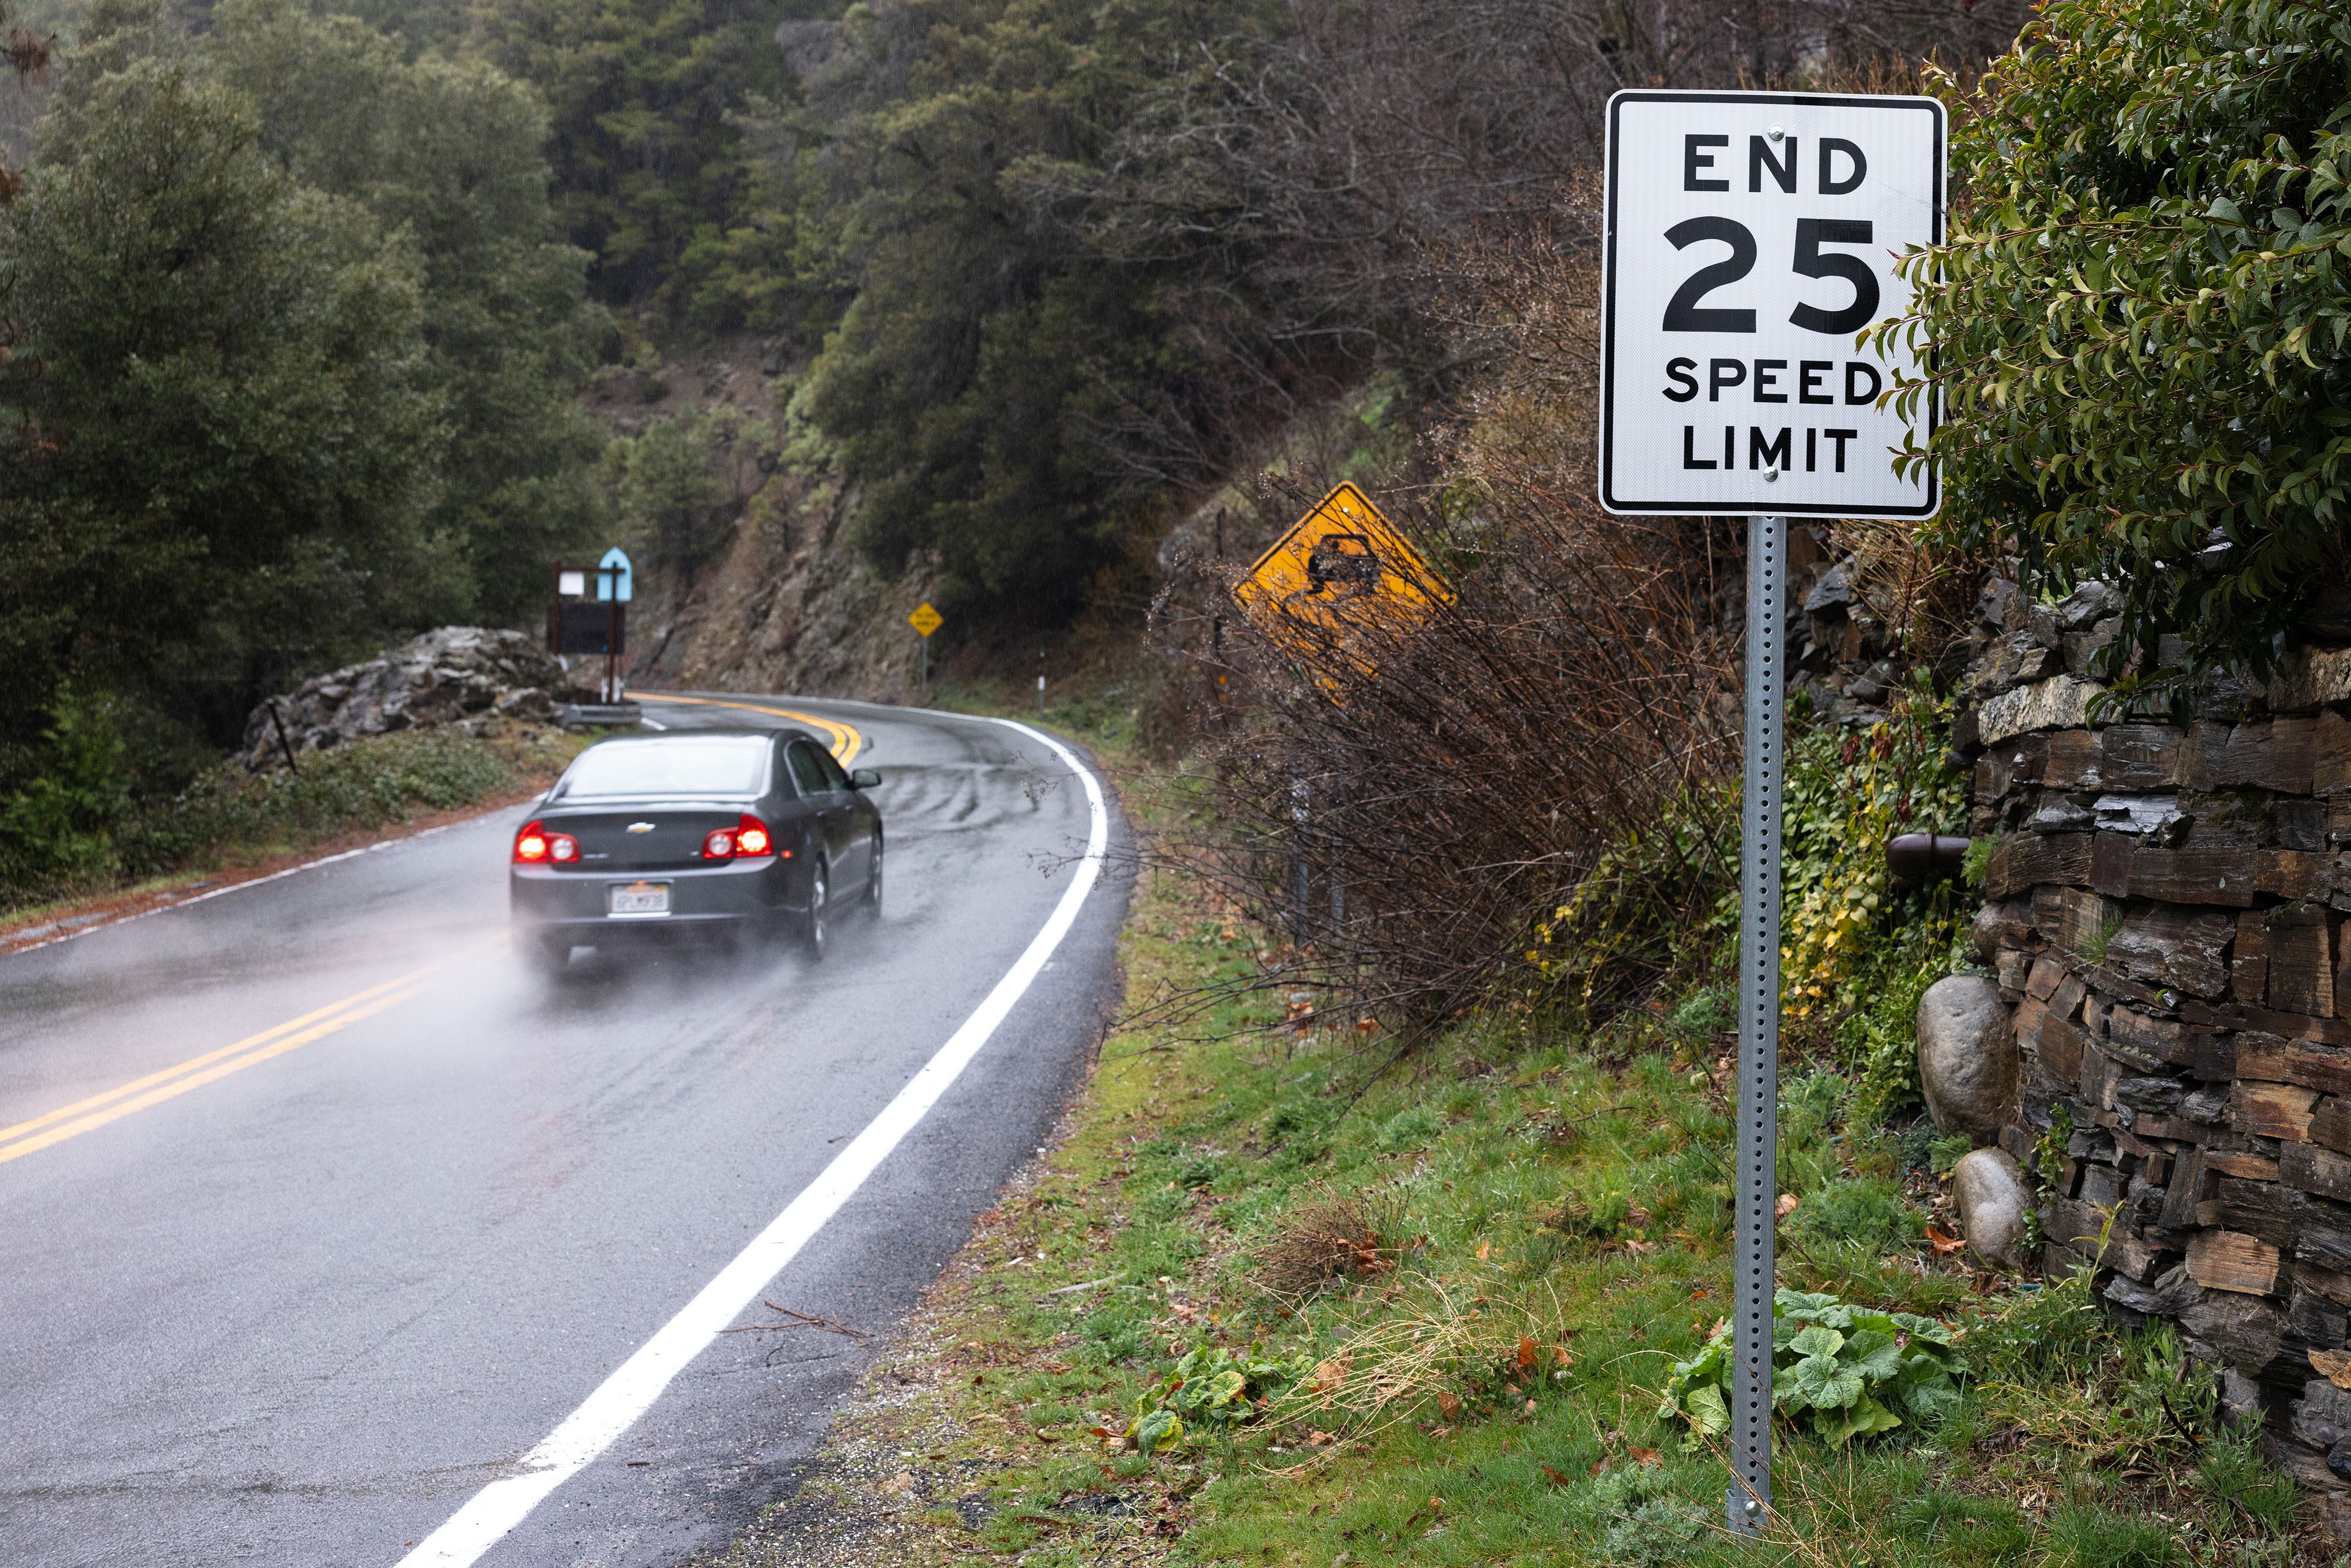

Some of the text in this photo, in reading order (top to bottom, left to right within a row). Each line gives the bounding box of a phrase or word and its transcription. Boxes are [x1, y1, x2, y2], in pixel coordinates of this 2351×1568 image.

[1684, 134, 1867, 195] END
[1662, 216, 1880, 335] 25
[1662, 357, 1882, 406] SPEED
[1683, 425, 1858, 473] LIMIT
